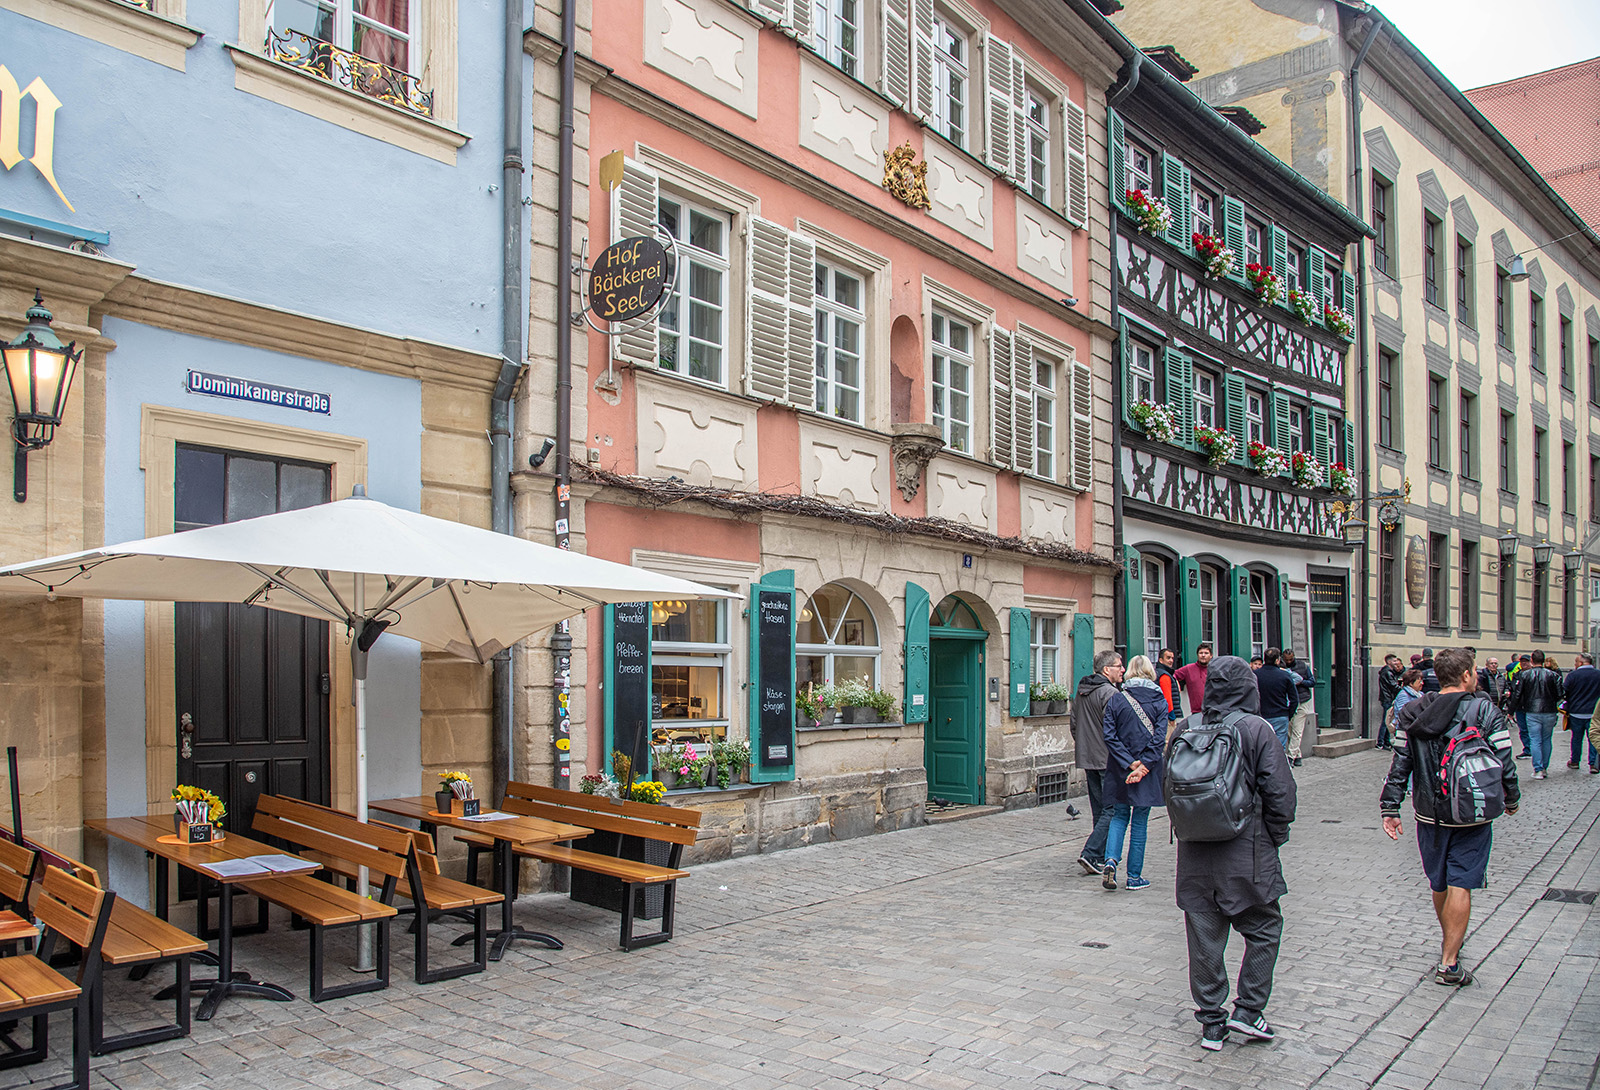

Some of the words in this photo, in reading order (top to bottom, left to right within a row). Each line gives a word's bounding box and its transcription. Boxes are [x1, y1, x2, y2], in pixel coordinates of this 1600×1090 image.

[607, 240, 643, 268] Hof
[593, 261, 660, 296] Bäckerei
[604, 285, 648, 316] Seel
[191, 371, 329, 412] Dominikanerstraße
[465, 802, 478, 815] 41
[193, 832, 205, 841] 42
